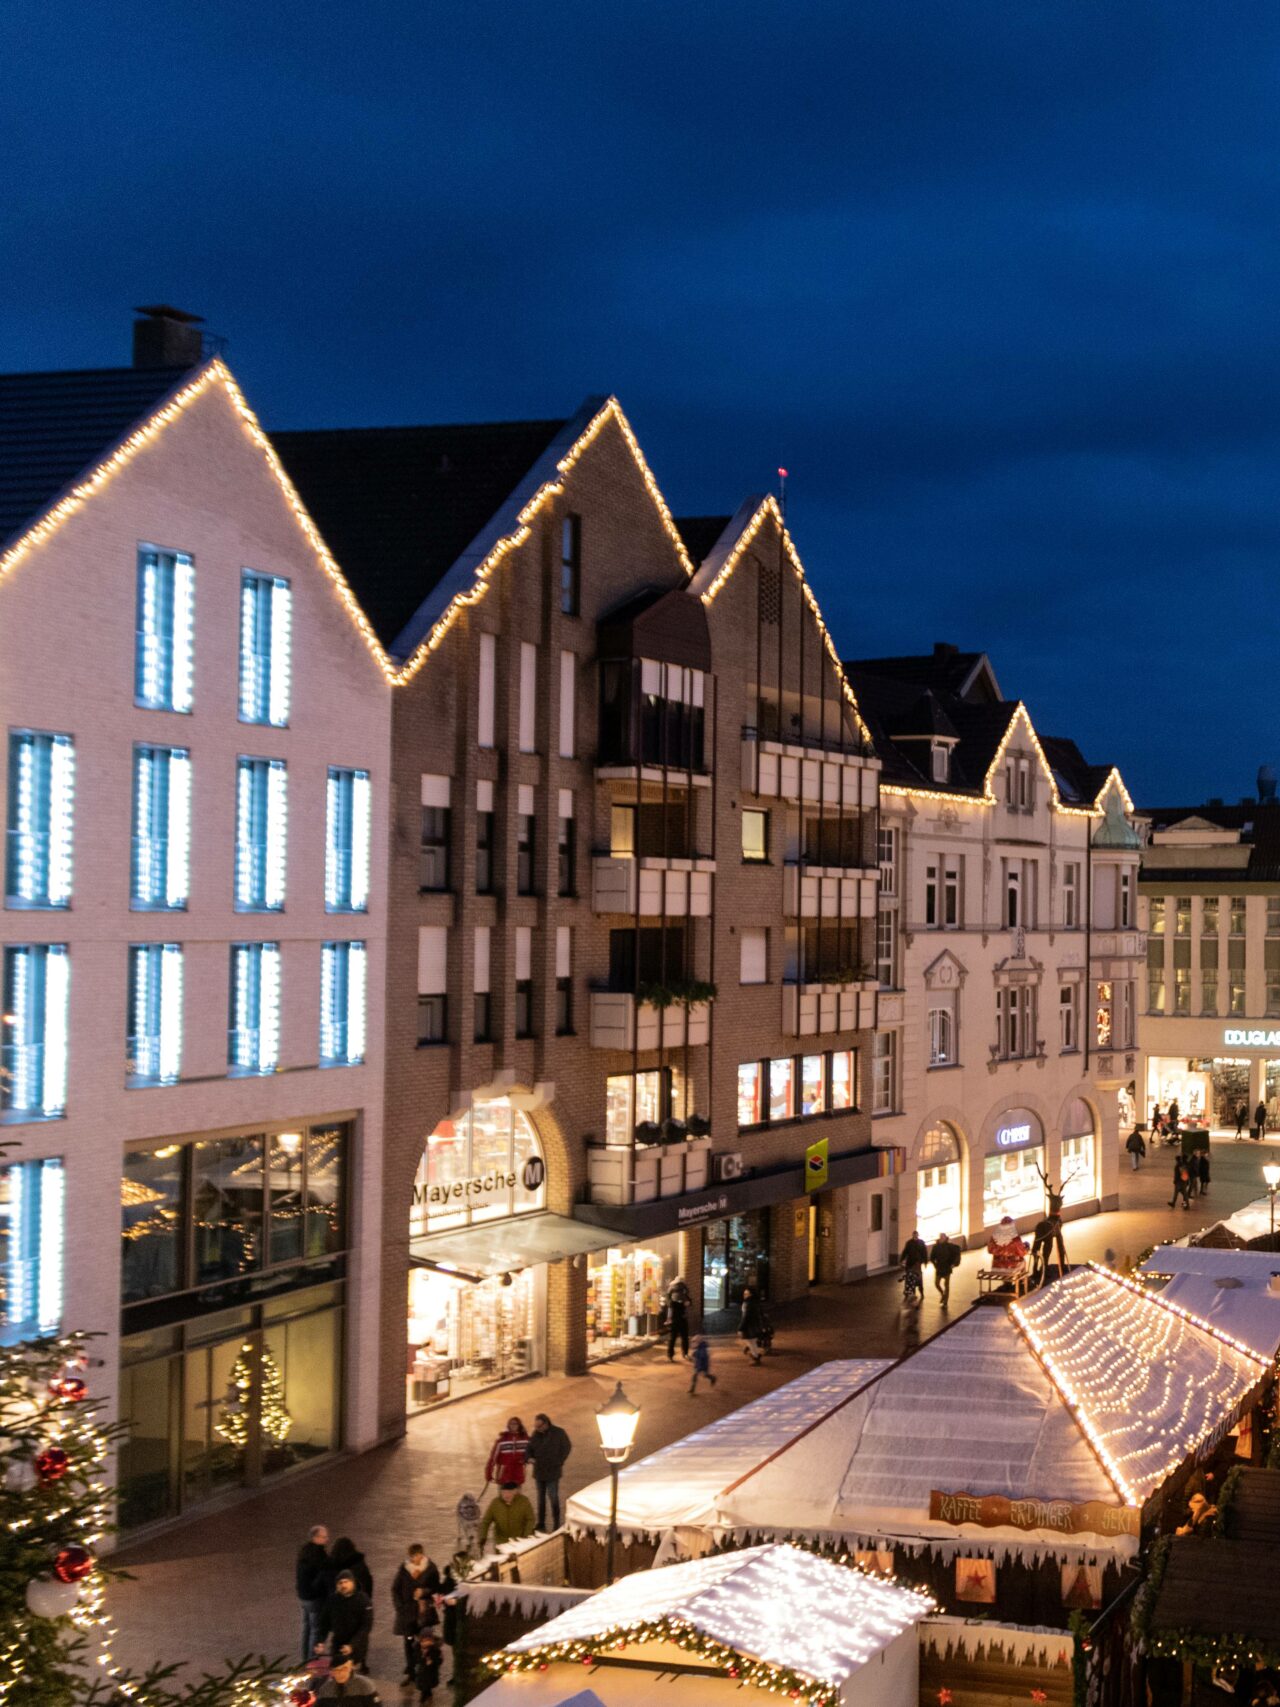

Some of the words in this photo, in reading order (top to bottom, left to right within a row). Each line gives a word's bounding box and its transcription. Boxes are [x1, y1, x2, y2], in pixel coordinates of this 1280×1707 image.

[412, 1170, 517, 1206] Mayersche
[679, 1202, 717, 1218] Mayersche
[940, 1496, 982, 1520] KAFFEE
[1010, 1500, 1074, 1530] ERDINGER
[1102, 1508, 1133, 1532] SEKT
